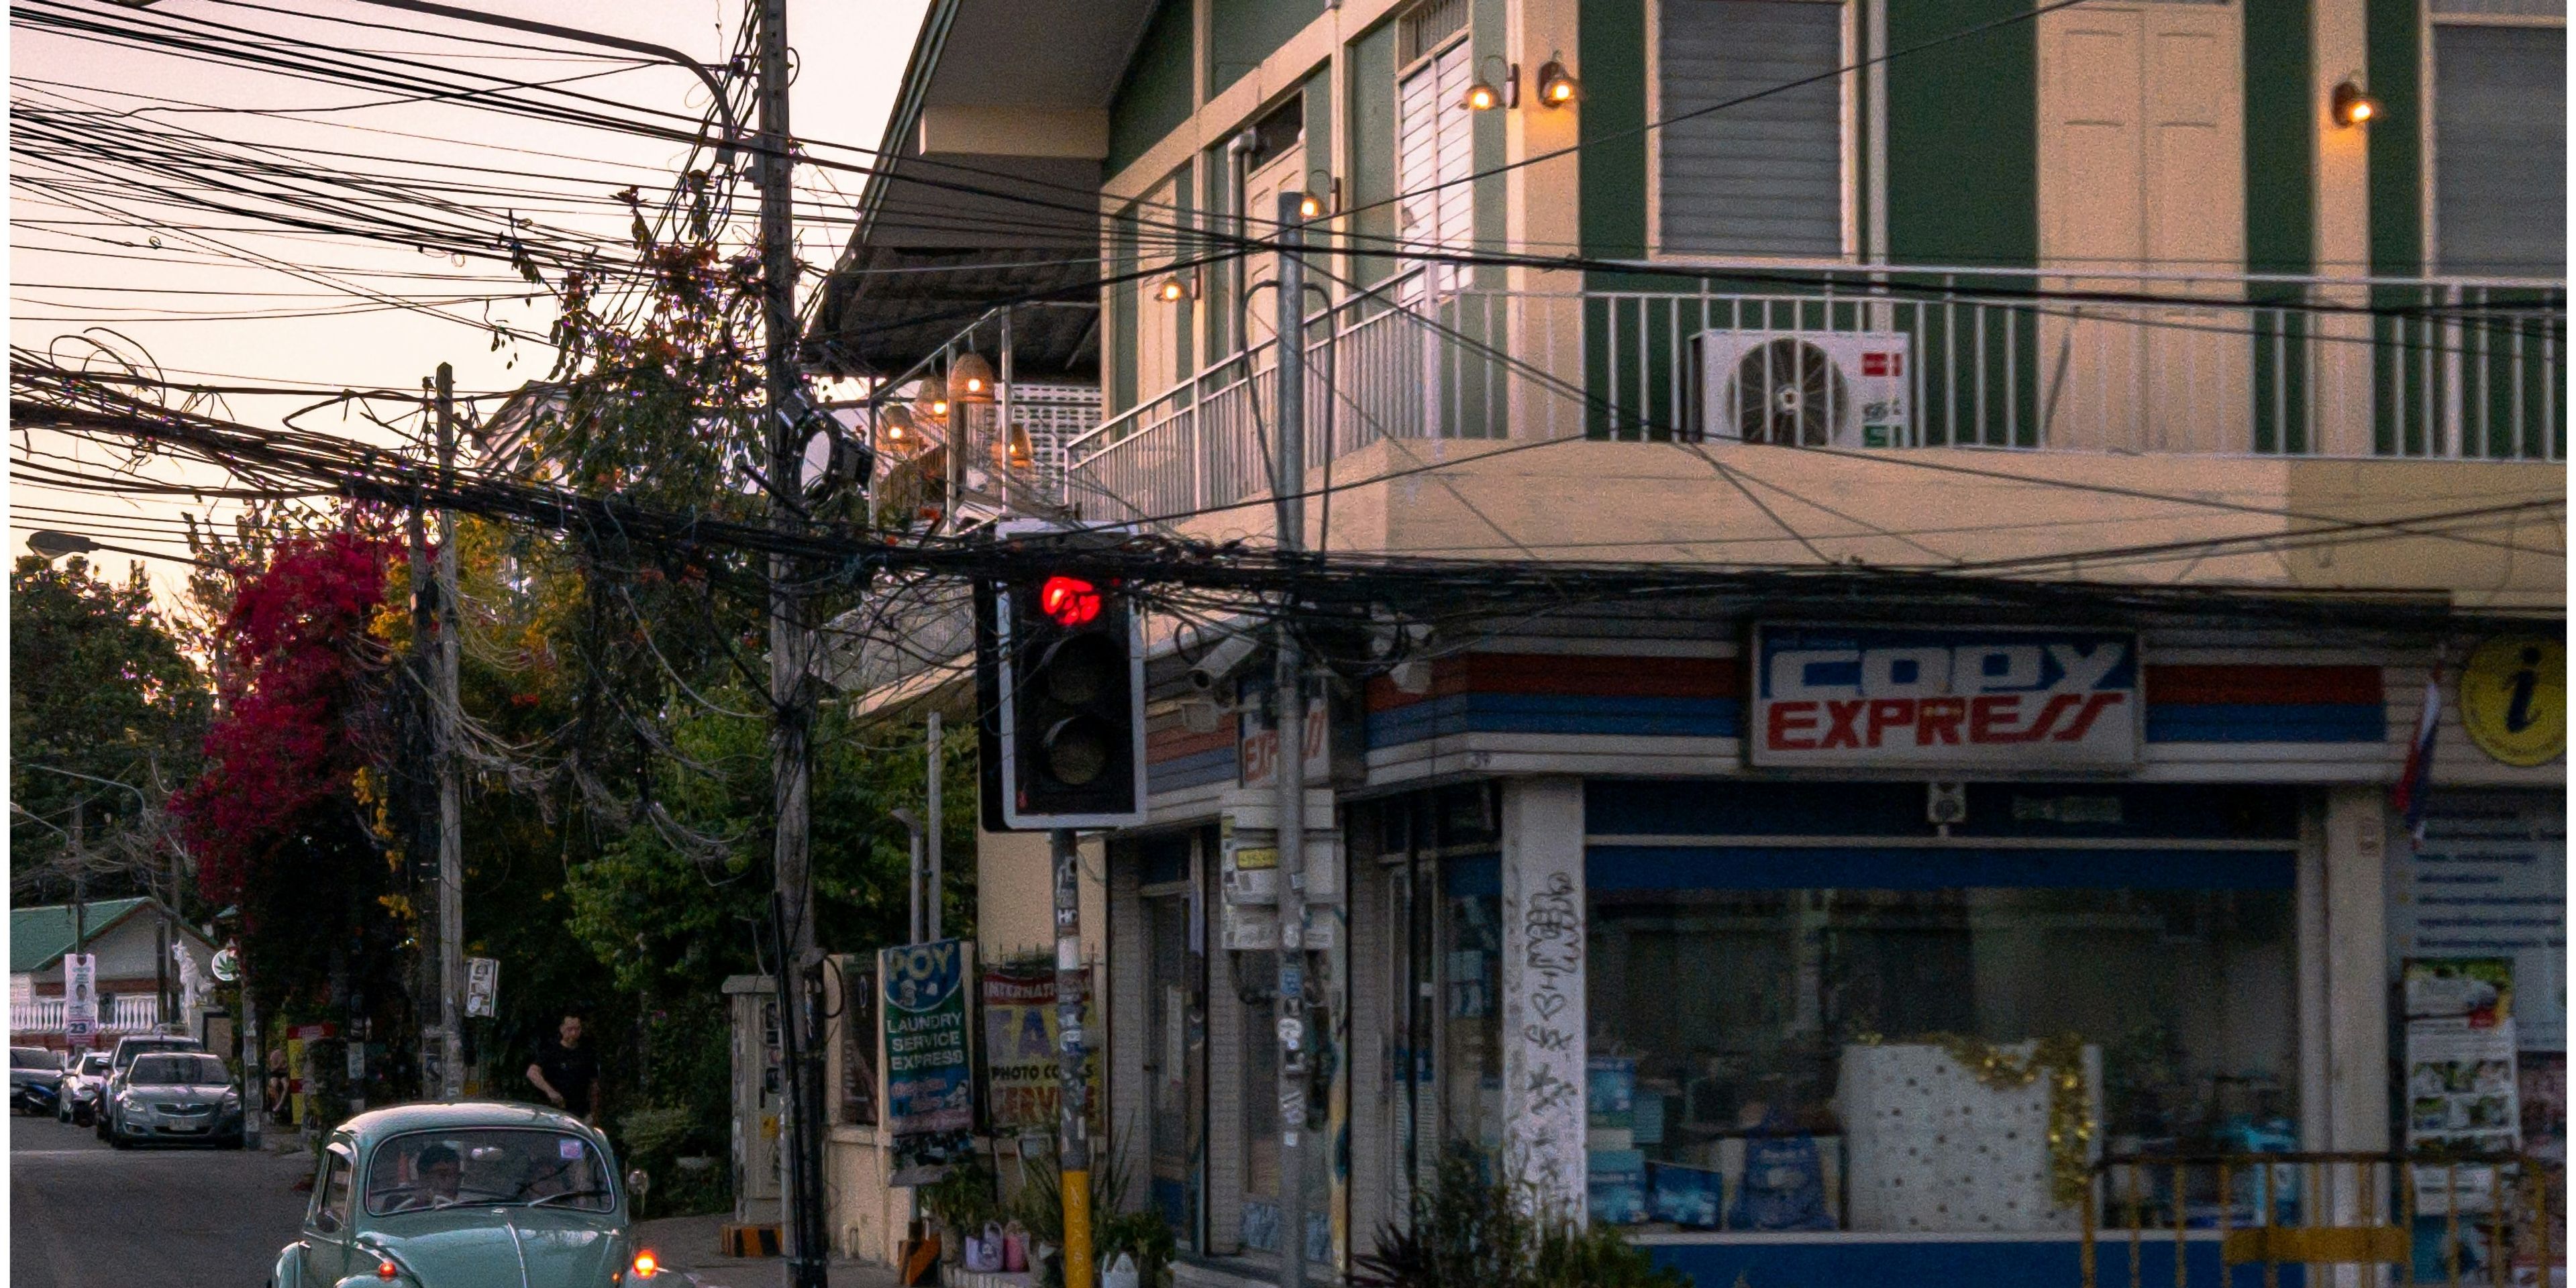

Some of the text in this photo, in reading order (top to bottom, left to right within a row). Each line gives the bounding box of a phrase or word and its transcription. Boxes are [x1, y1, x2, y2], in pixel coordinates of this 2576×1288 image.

[1769, 643, 2126, 695] COPY
[1768, 692, 2123, 750] EXPRESS
[890, 942, 954, 981] POY
[886, 1012, 963, 1034] LAUNDRY
[986, 1006, 1094, 1060] FA
[892, 1030, 961, 1053] SERVICE
[891, 1049, 964, 1071] EXPRESS
[991, 1065, 1039, 1080] PHOTO
